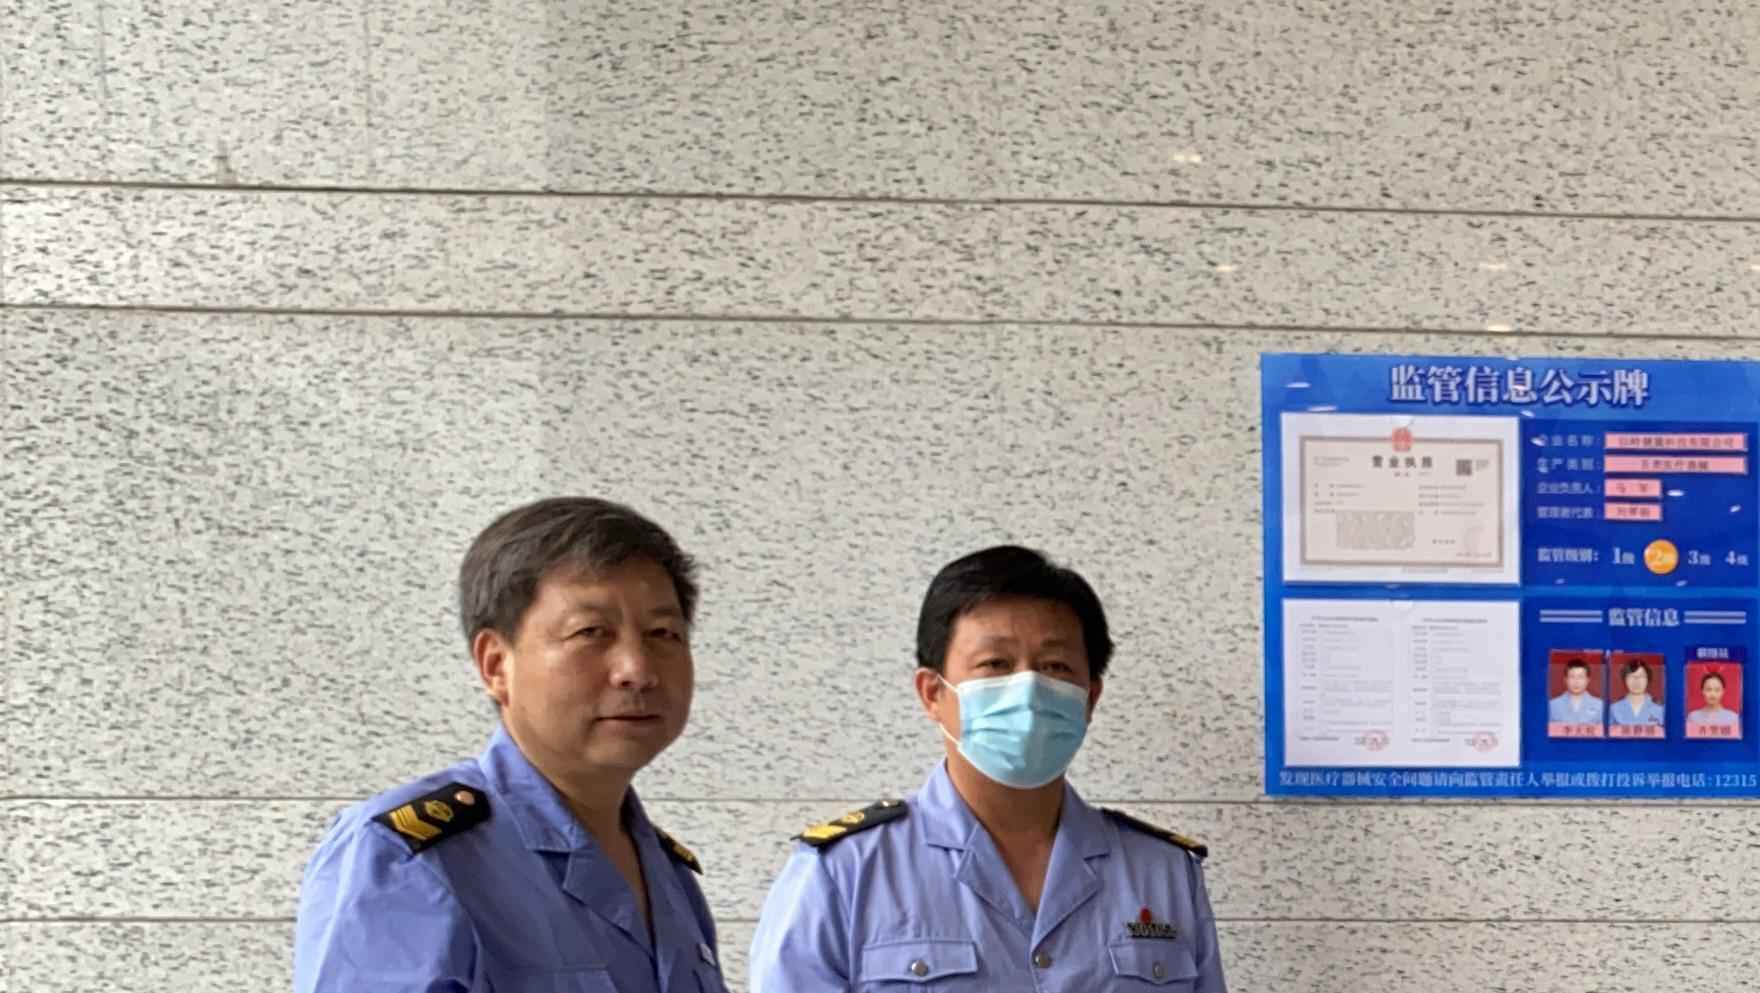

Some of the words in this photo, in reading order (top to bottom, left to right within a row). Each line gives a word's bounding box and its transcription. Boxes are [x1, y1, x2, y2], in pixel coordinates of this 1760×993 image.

[1390, 366, 1650, 407] 监管信息公示牌
